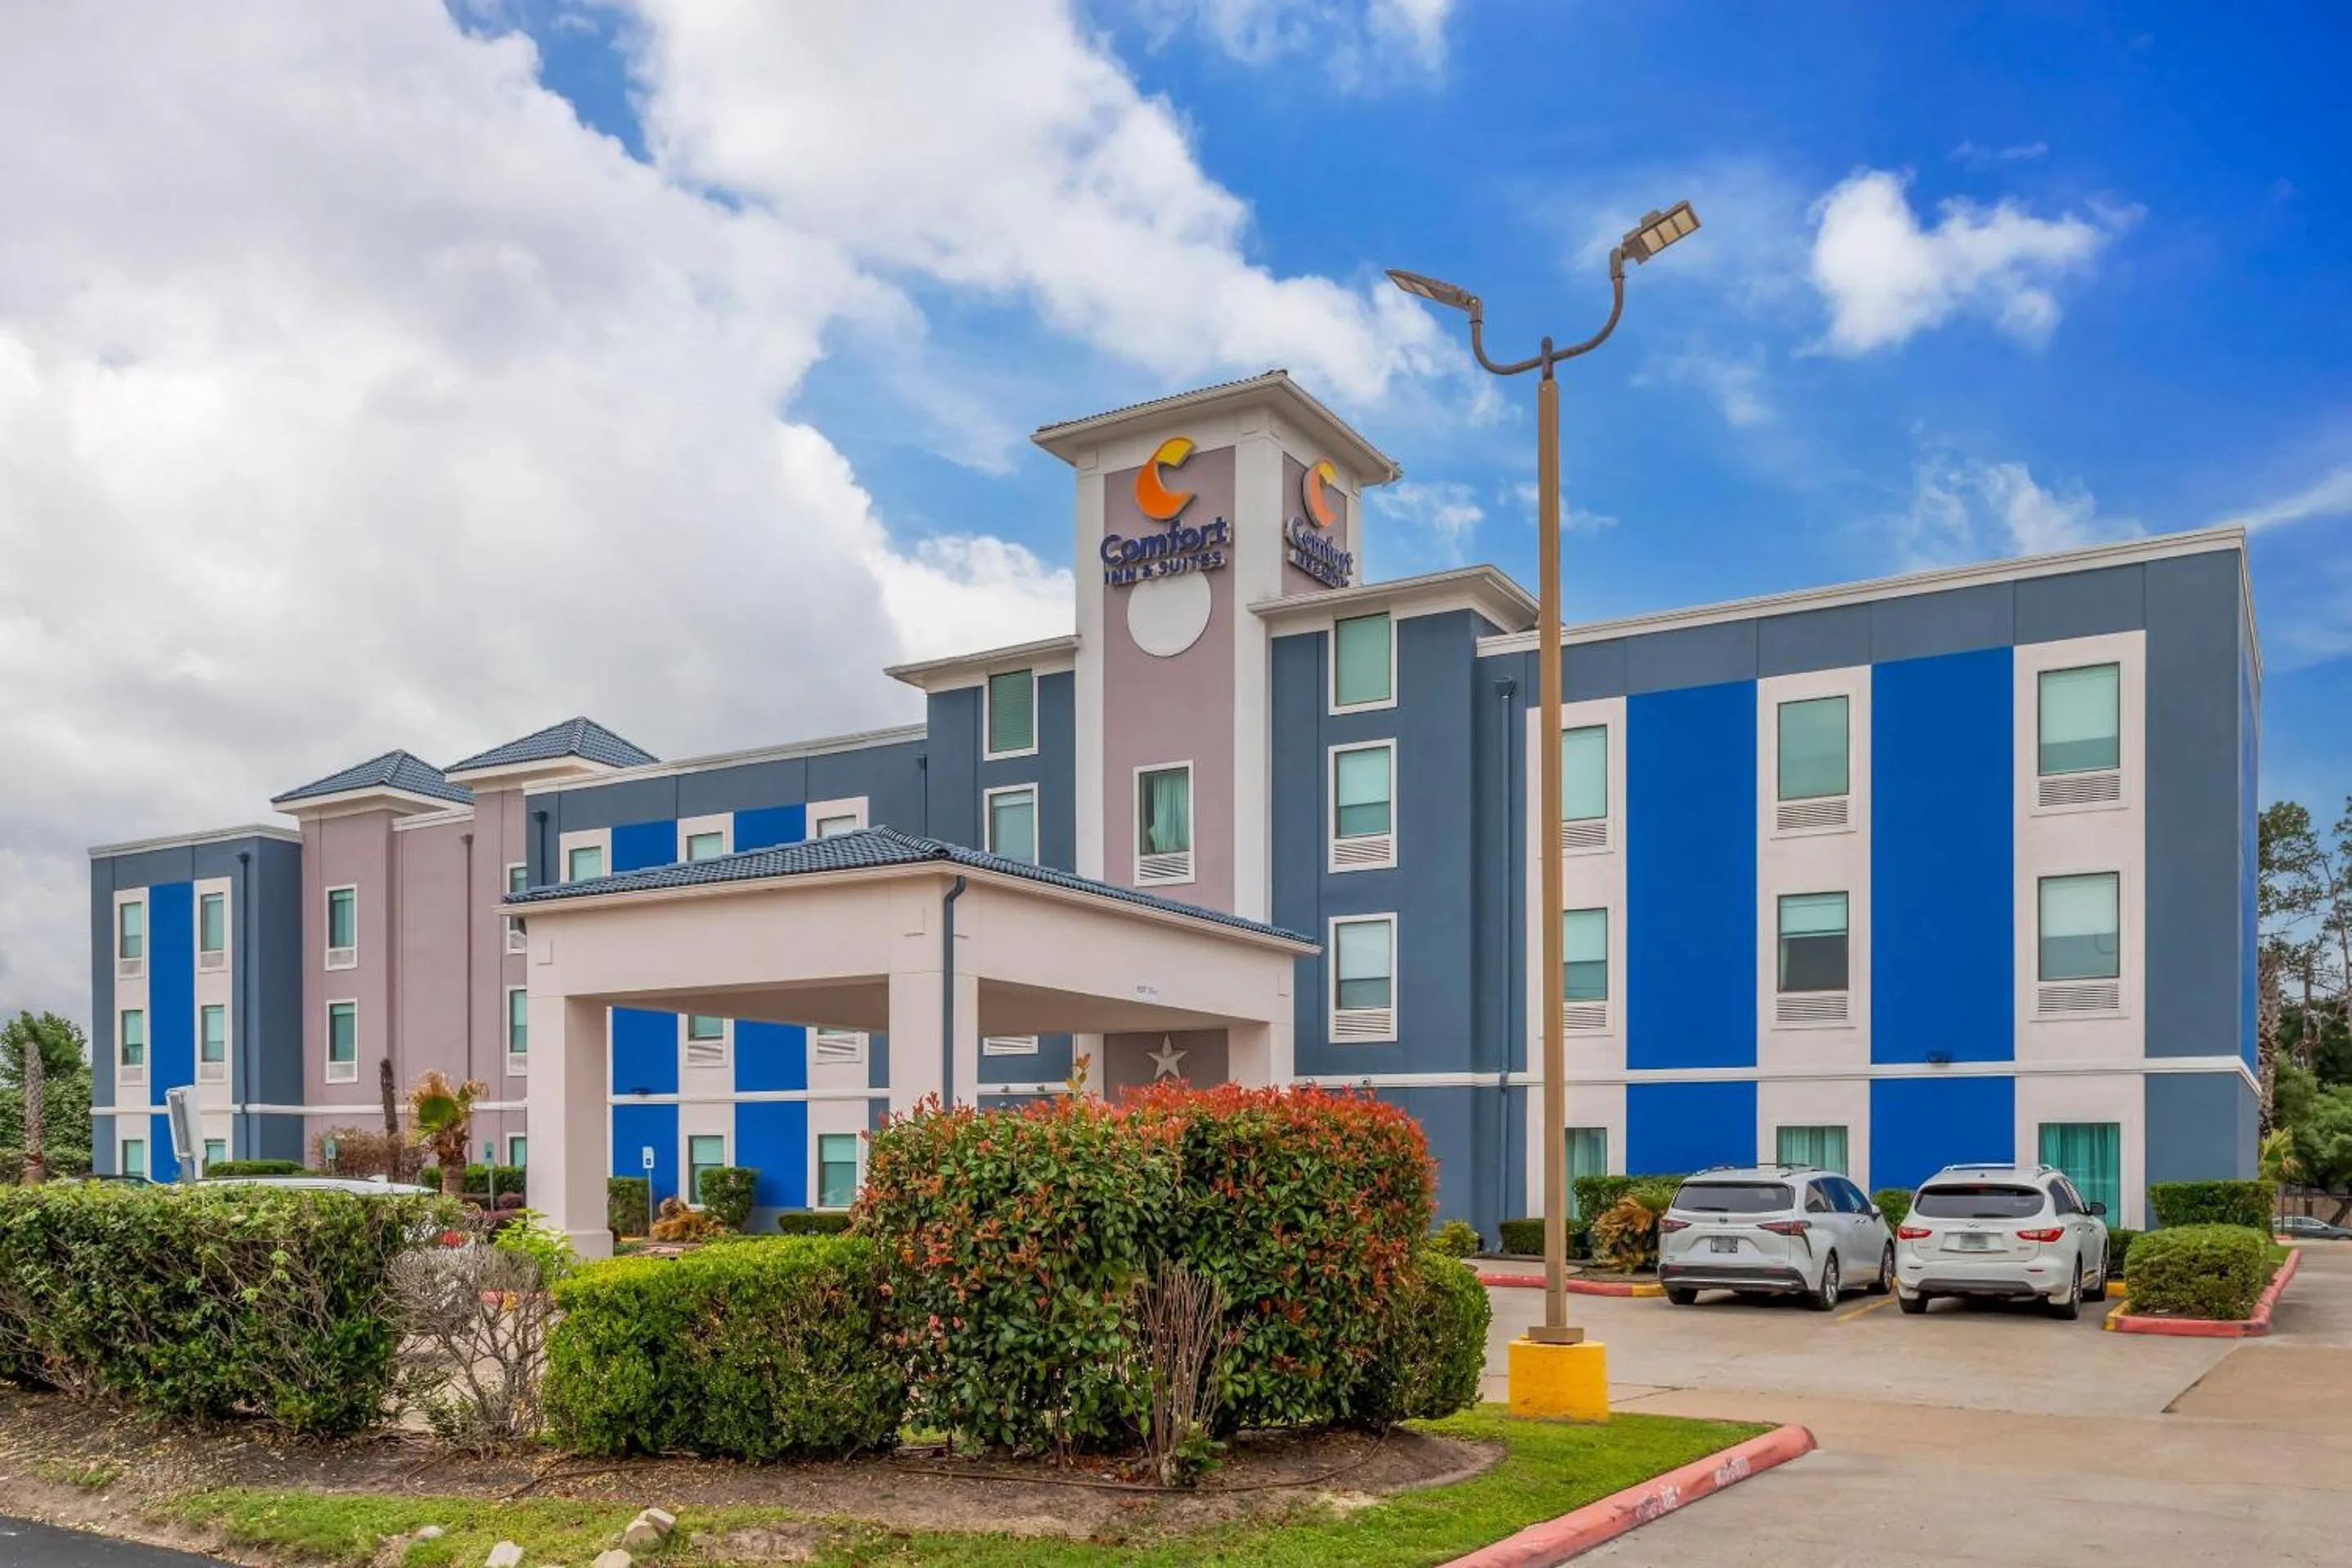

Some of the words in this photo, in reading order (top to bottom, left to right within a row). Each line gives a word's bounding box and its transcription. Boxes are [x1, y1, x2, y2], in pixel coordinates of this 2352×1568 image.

[1101, 516, 1229, 565] Comfort
[1104, 565, 1138, 585] INN
[1142, 564, 1155, 578] &
[1158, 551, 1224, 576] SUITES
